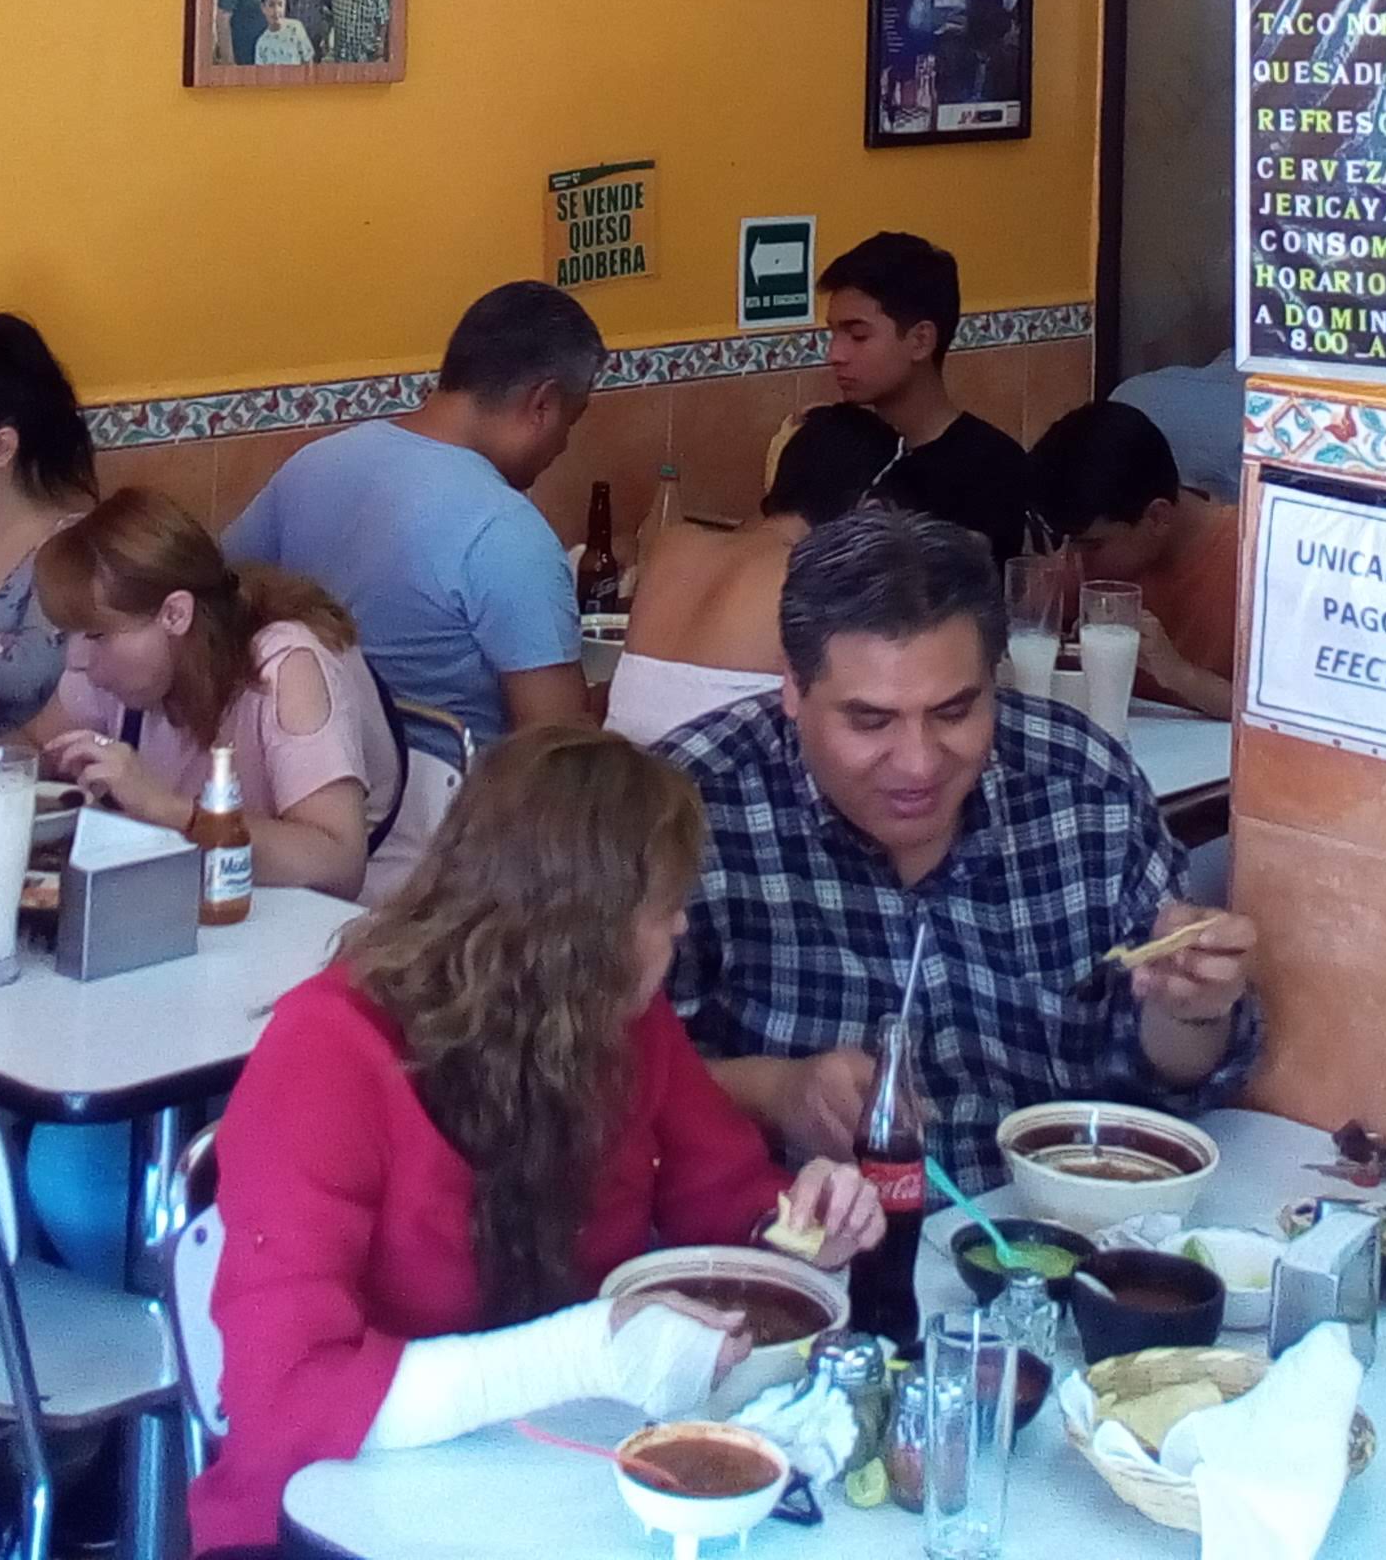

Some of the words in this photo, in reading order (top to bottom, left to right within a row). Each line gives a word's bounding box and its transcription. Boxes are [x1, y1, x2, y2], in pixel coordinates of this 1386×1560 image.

[1259, 12, 1337, 36] TACO
[557, 191, 578, 221] SE
[582, 182, 644, 217] VENDE
[569, 214, 631, 254] QUESO
[557, 245, 645, 287] ADOBERA
[1255, 267, 1386, 297] HORARIO
[1255, 305, 1273, 324] A
